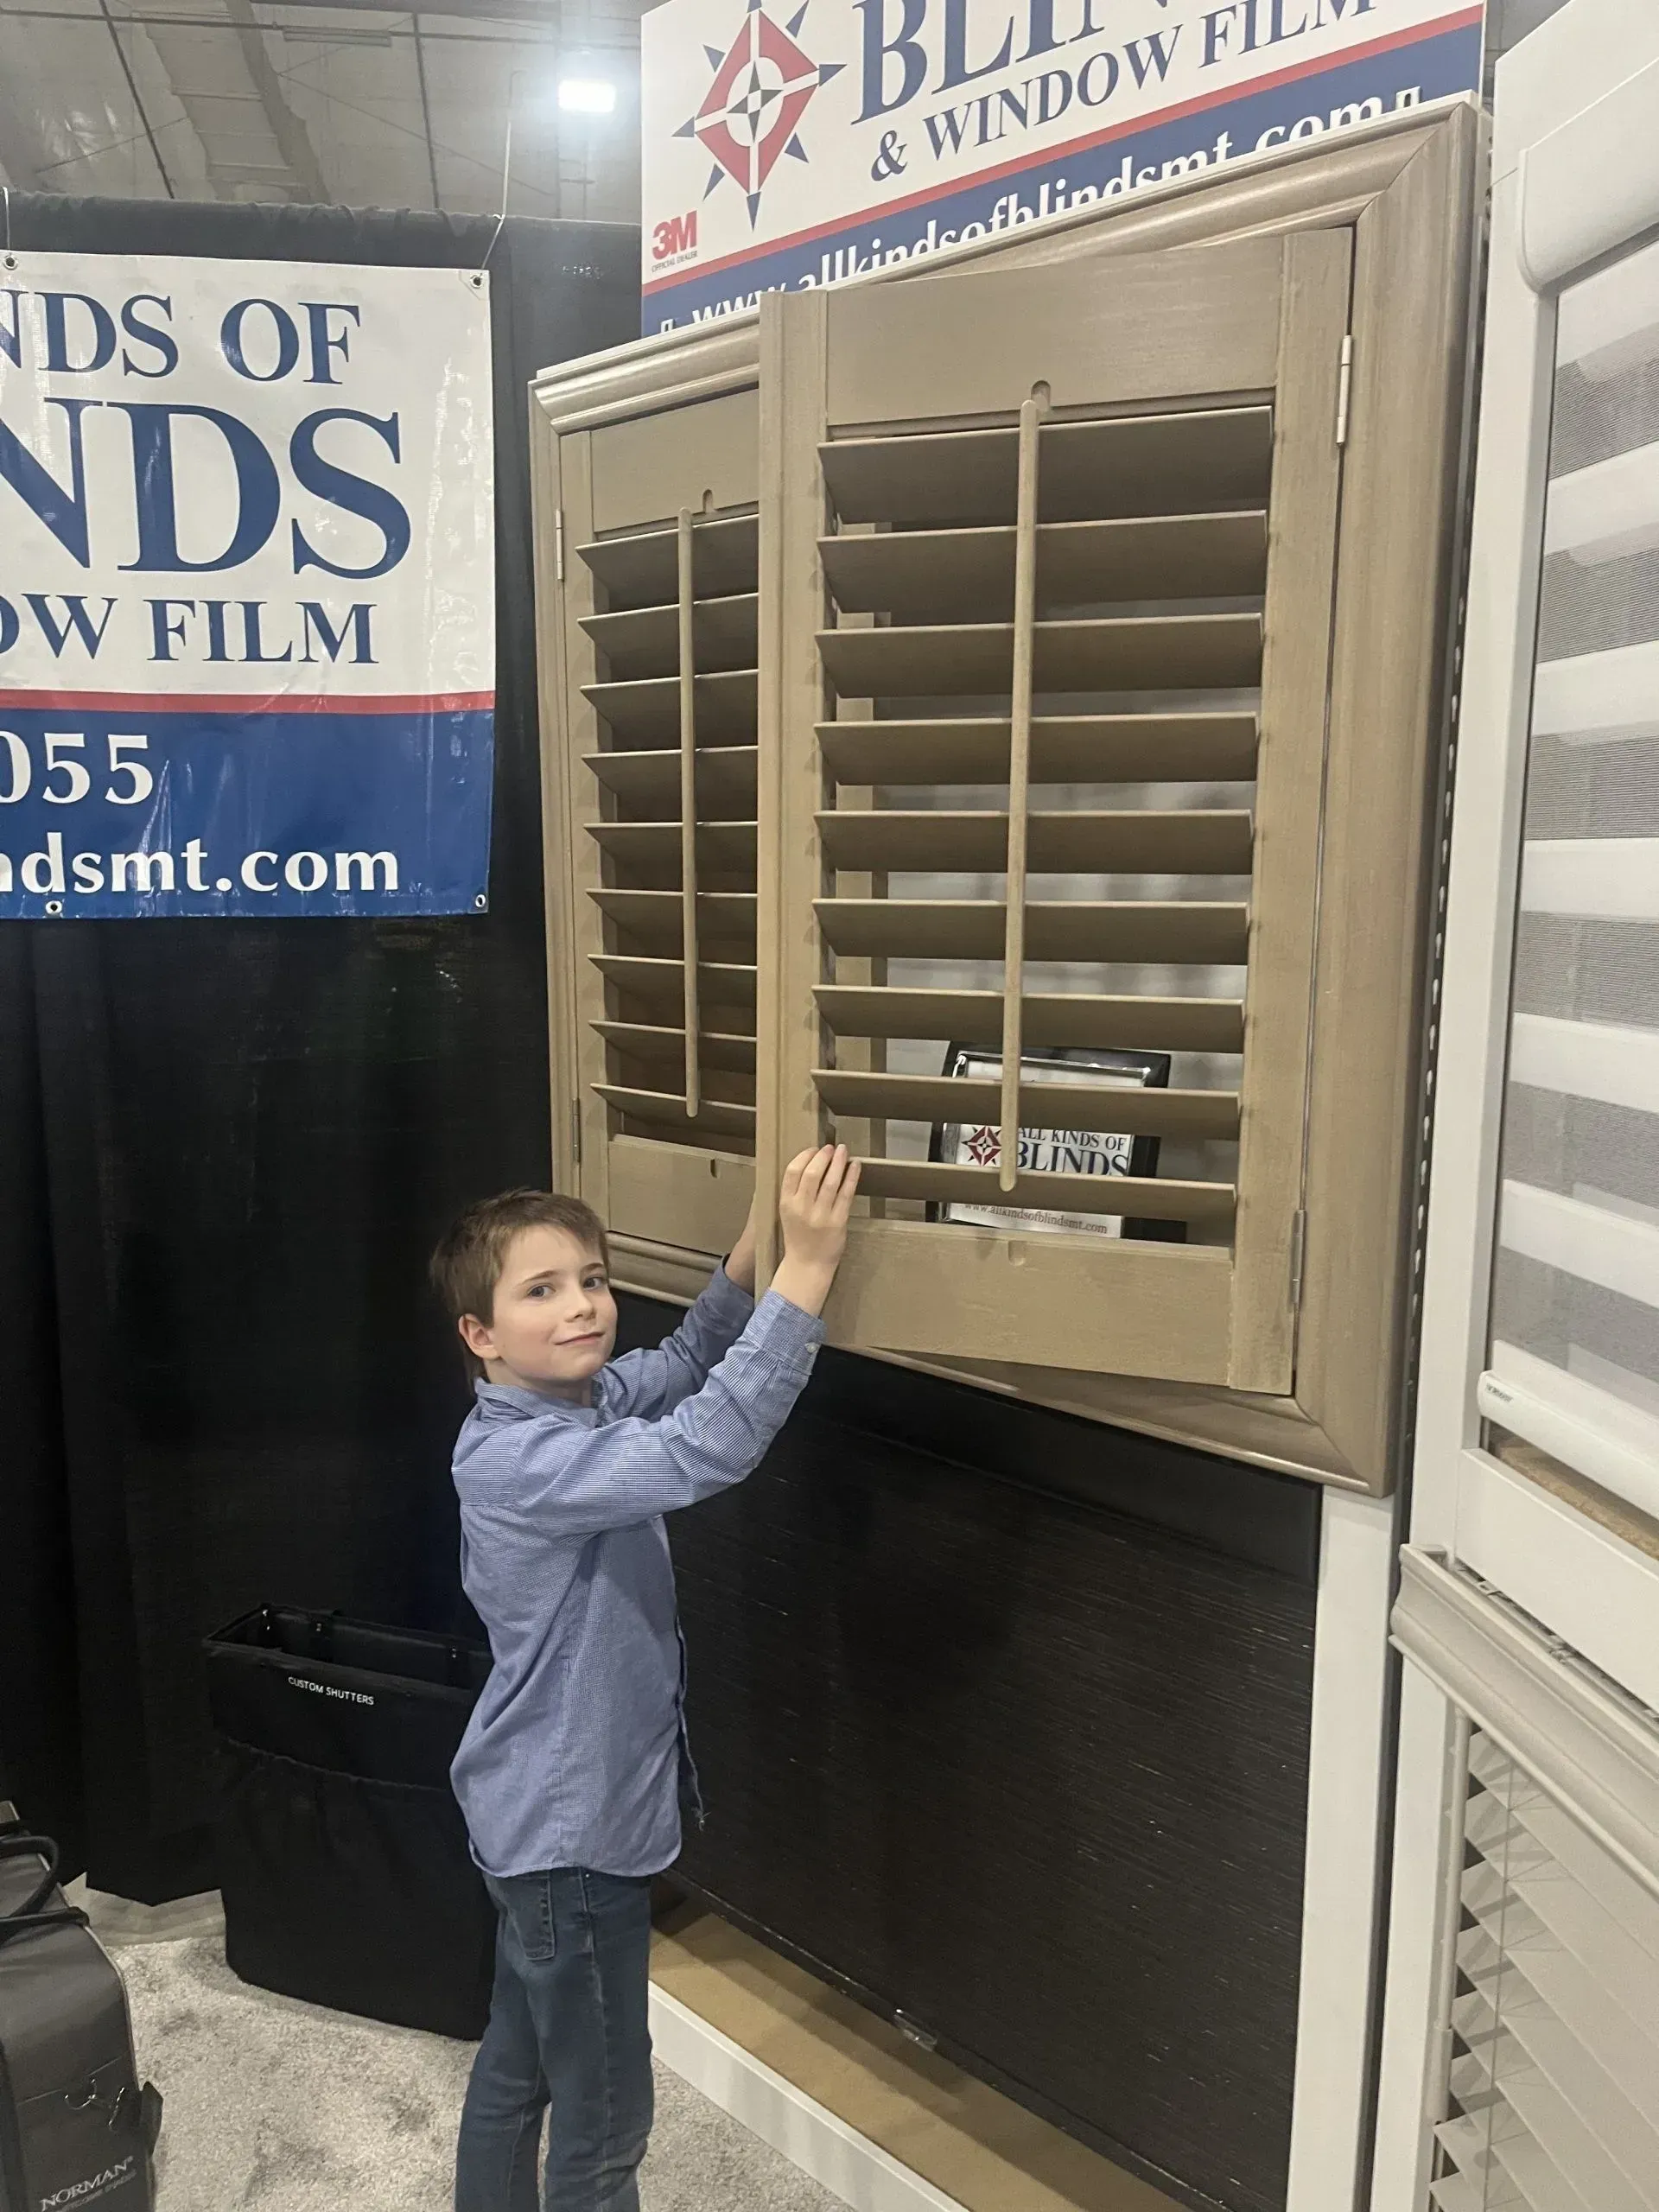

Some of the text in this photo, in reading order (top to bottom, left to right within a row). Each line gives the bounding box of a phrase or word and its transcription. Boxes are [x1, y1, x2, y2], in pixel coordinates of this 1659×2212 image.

[871, 130, 908, 181] &
[923, 24, 1183, 162] WINDOW
[652, 210, 697, 259] 3M
[220, 298, 360, 385] OF
[0, 397, 411, 579] NDS
[143, 599, 379, 664] FILM
[0, 832, 398, 893] dsmt.com
[1018, 1128, 1127, 1151] ALL KINDS OF
[288, 1676, 374, 1706] CUSTOM SHUTTERS
